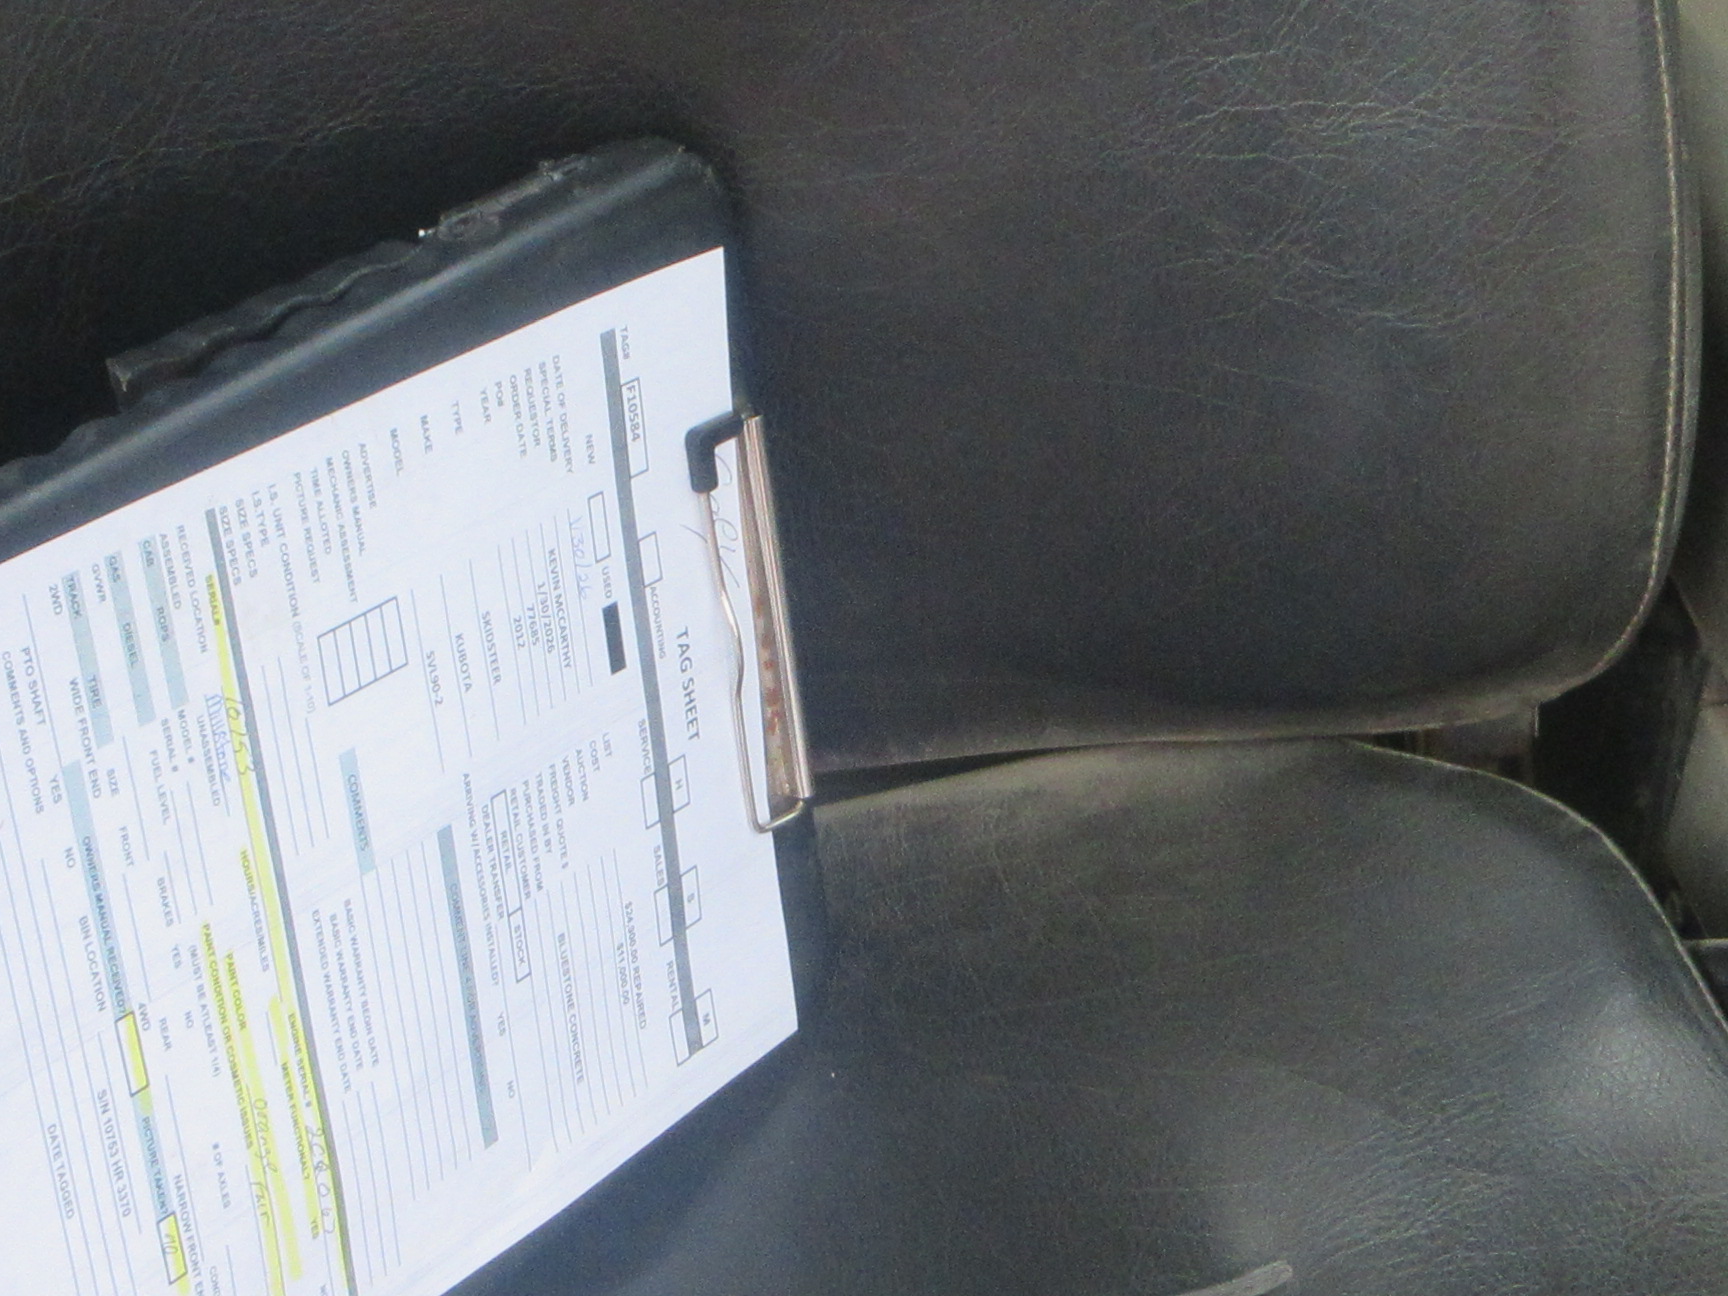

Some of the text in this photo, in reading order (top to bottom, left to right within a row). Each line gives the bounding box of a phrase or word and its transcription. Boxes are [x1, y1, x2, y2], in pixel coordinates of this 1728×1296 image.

[419, 413, 433, 455] MAKE
[450, 400, 462, 436] TYPE
[479, 387, 491, 425] YEAR
[508, 373, 527, 459] ORDER DATE
[522, 366, 540, 448] REQUESTOR
[537, 360, 557, 463] SPECIAL TERMS
[551, 353, 573, 476] DATE OF DELIVERY
[625, 383, 640, 443] F10584
[389, 427, 404, 477] MODEL
[584, 433, 595, 466] NEW
[293, 471, 319, 585] PICTURE REQUEST
[341, 448, 366, 557] OWNERS MANUAL
[176, 524, 208, 654] RECEIVED LOCATION
[547, 547, 571, 672] KEVIN MCCARTHY
[601, 565, 612, 600] USED
[122, 621, 138, 669] DIESEL
[512, 613, 525, 651] 2012
[526, 602, 539, 647] 77685
[536, 579, 555, 655] 1/30/2026
[649, 583, 666, 661] ACCOUNTING
[454, 631, 472, 694] KUBOTA
[481, 608, 501, 687] SKIDSTEER
[20, 646, 45, 726] PTO SHAFT
[87, 674, 101, 710] TIRE
[425, 648, 443, 708] SVL90-2
[675, 626, 699, 746] TAG SHEET
[0, 650, 44, 815] COMMENTS AND OPTIONS
[68, 677, 101, 799] WIDE FRONT END
[589, 738, 599, 774] COST
[602, 731, 611, 759] LIST
[637, 717, 651, 776] SERVICE
[48, 775, 61, 804] YES
[149, 749, 170, 825] FUEL LEVEL
[561, 754, 574, 807] VENDOR
[575, 746, 588, 802] AUCTION
[347, 772, 368, 853] COMMENTS
[521, 779, 544, 892] PURCHASED FROM
[534, 771, 547, 822] TRADED
[543, 837, 552, 856] BY
[547, 762, 561, 816] FREIGHT
[555, 817, 567, 860] QUOTE
[63, 847, 75, 870] NO
[480, 803, 505, 921] DEALER TRANSFER
[499, 829, 512, 875] RETAIL
[508, 786, 531, 901] RETAIL CUSTOMER
[652, 844, 664, 888] SALES
[156, 876, 173, 928] BRAKES
[513, 923, 526, 967] STOCK
[83, 941, 106, 1012] LOCATION
[631, 964, 647, 1031] REPAIRED
[666, 959, 679, 1011] RENTAL
[496, 1011, 506, 1037] YES
[556, 931, 585, 1085] BLUESTONE CONCRETE
[506, 1079, 515, 1100] NO
[102, 1116, 118, 1158] 10753
[46, 1122, 75, 1220] DATE TAGGED
[111, 1159, 123, 1183] HR
[116, 1183, 130, 1218] 3370
[172, 1173, 193, 1236] NARROW
[184, 1233, 202, 1281] FRONT
